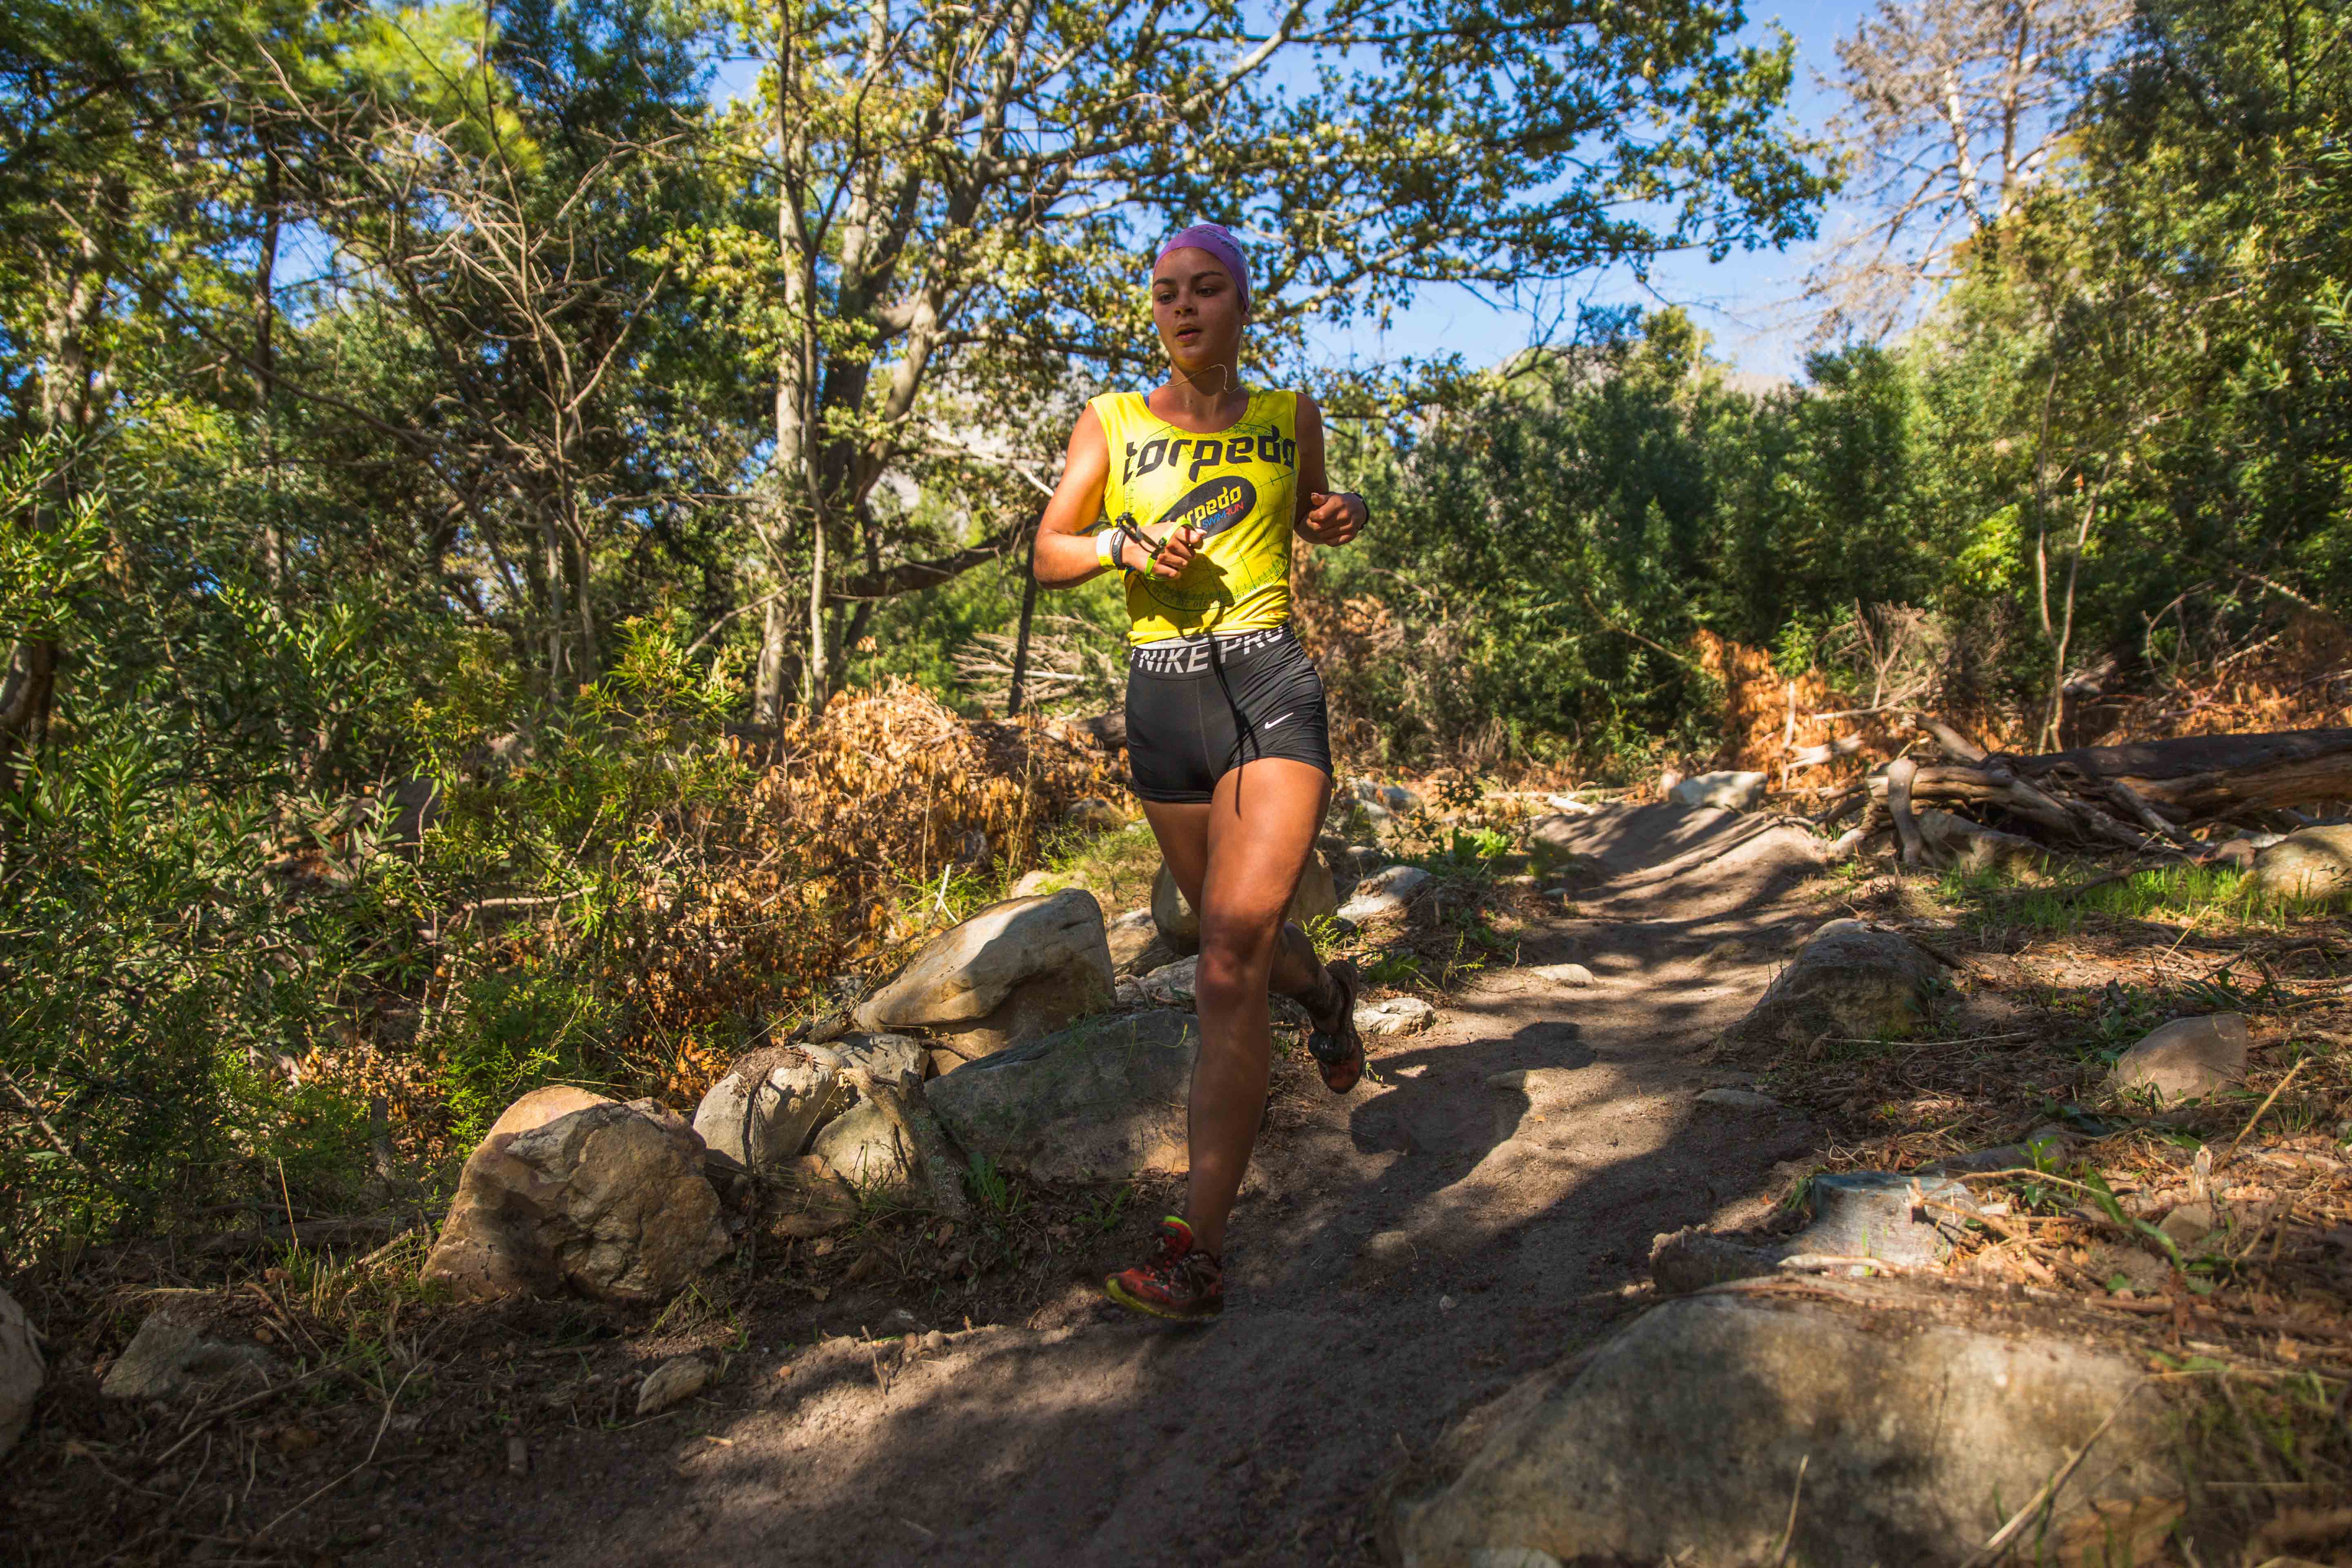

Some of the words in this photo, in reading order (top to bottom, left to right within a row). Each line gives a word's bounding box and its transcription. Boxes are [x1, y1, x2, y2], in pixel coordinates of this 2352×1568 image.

[1123, 425, 1296, 485] torpedo
[1176, 486, 1242, 528] rpedo
[1138, 644, 1211, 673] NIKE
